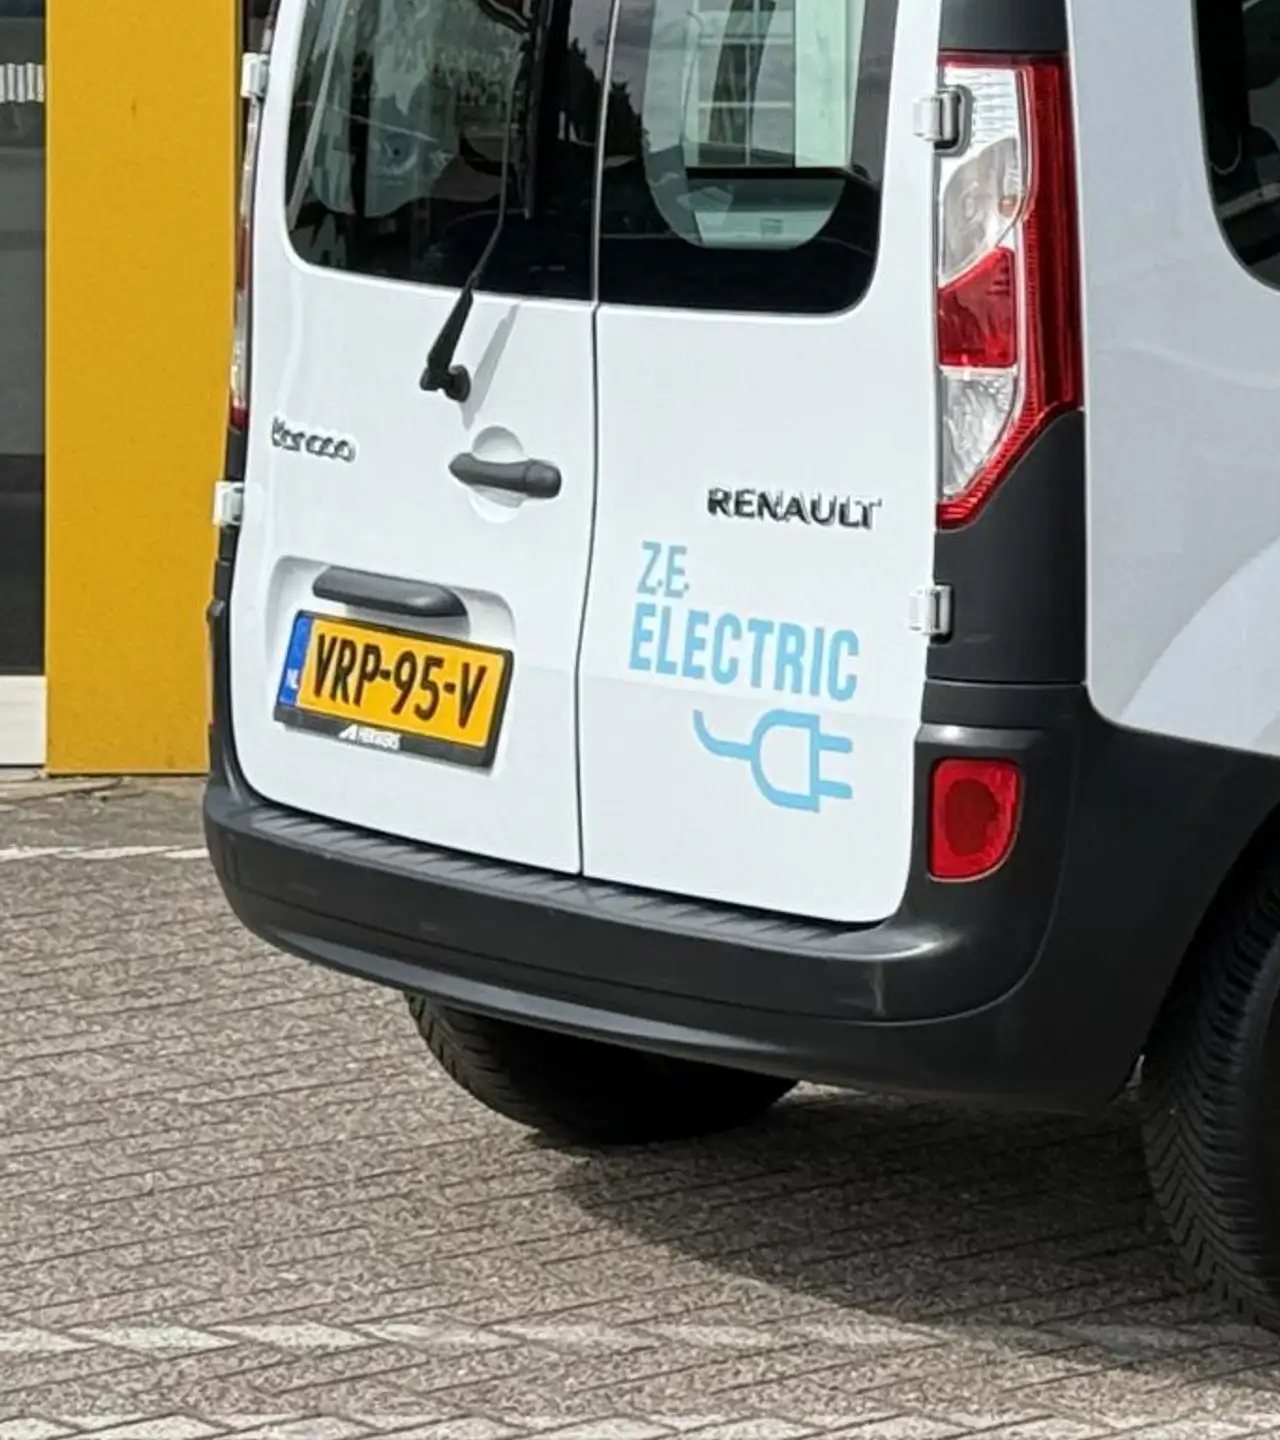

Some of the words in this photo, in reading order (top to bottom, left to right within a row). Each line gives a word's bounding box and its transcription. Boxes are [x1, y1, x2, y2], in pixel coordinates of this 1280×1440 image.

[706, 487, 882, 530] RENAULT
[314, 633, 488, 729] VRP-95-V
[628, 601, 860, 701] ELECTRIC
